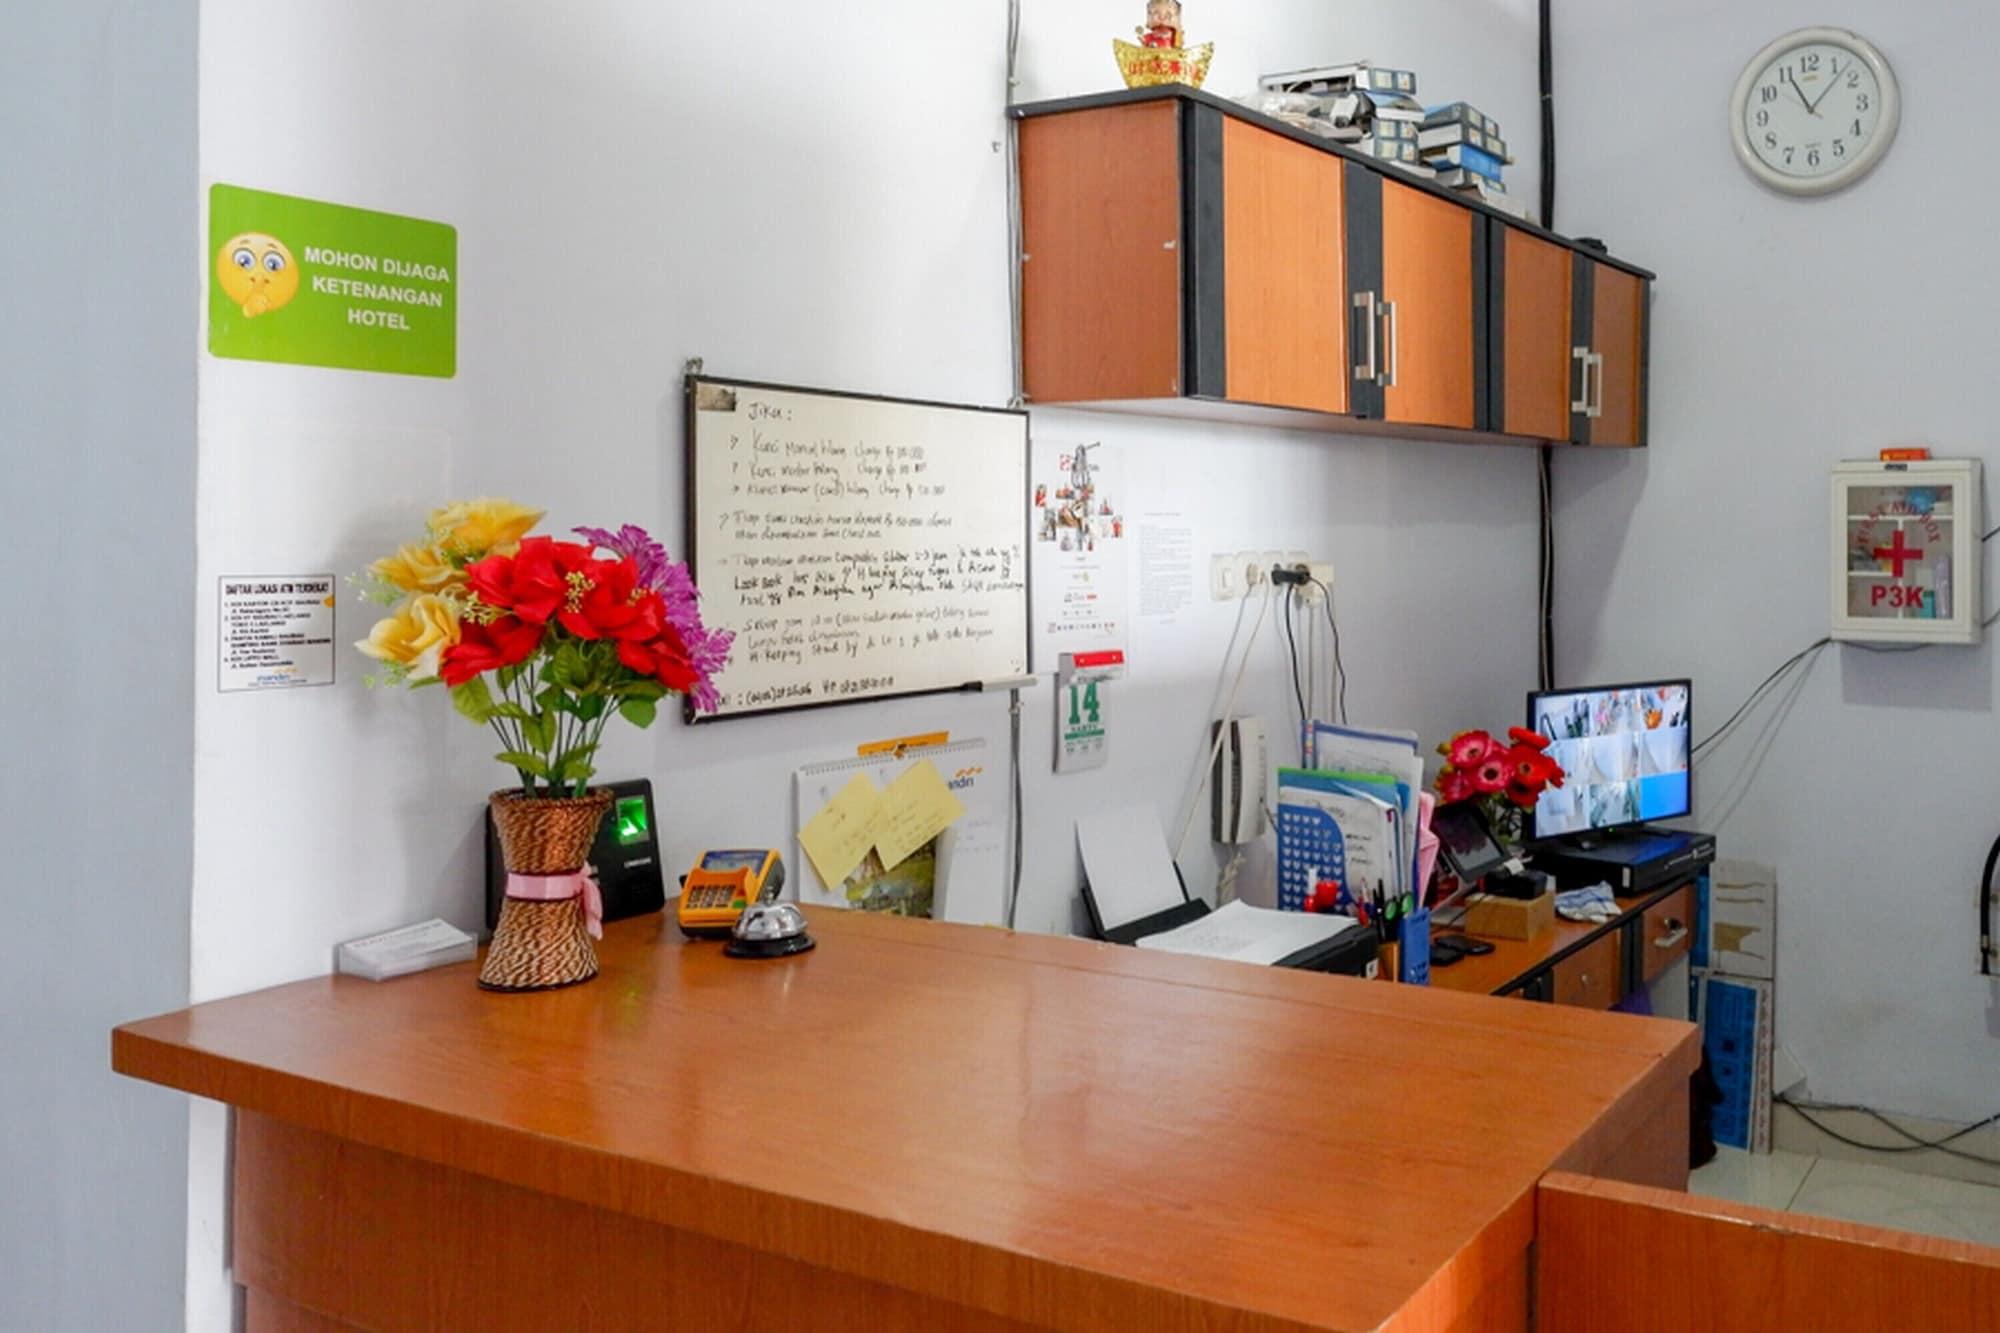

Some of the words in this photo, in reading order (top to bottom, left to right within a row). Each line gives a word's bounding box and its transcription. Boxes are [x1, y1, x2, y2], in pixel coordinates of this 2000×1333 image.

[1800, 54, 1820, 73] 12
[1830, 57, 1838, 74] 1
[1779, 66, 1794, 83] 11
[1847, 72, 1858, 88] 2
[1762, 85, 1777, 103] 10
[1856, 93, 1869, 111] 3
[1756, 110, 1769, 127] 9
[1850, 119, 1861, 136] 4
[1765, 132, 1777, 149] 8
[1833, 139, 1844, 157] 5
[1783, 146, 1795, 164] 7
[1807, 149, 1820, 166] 6
[304, 246, 377, 272] MOHON
[383, 258, 450, 283] DIJAGA
[312, 275, 443, 307] KETENANGAN
[347, 308, 411, 331] HOTEL
[1871, 585, 1924, 609] P3K
[1068, 681, 1099, 724] 14
